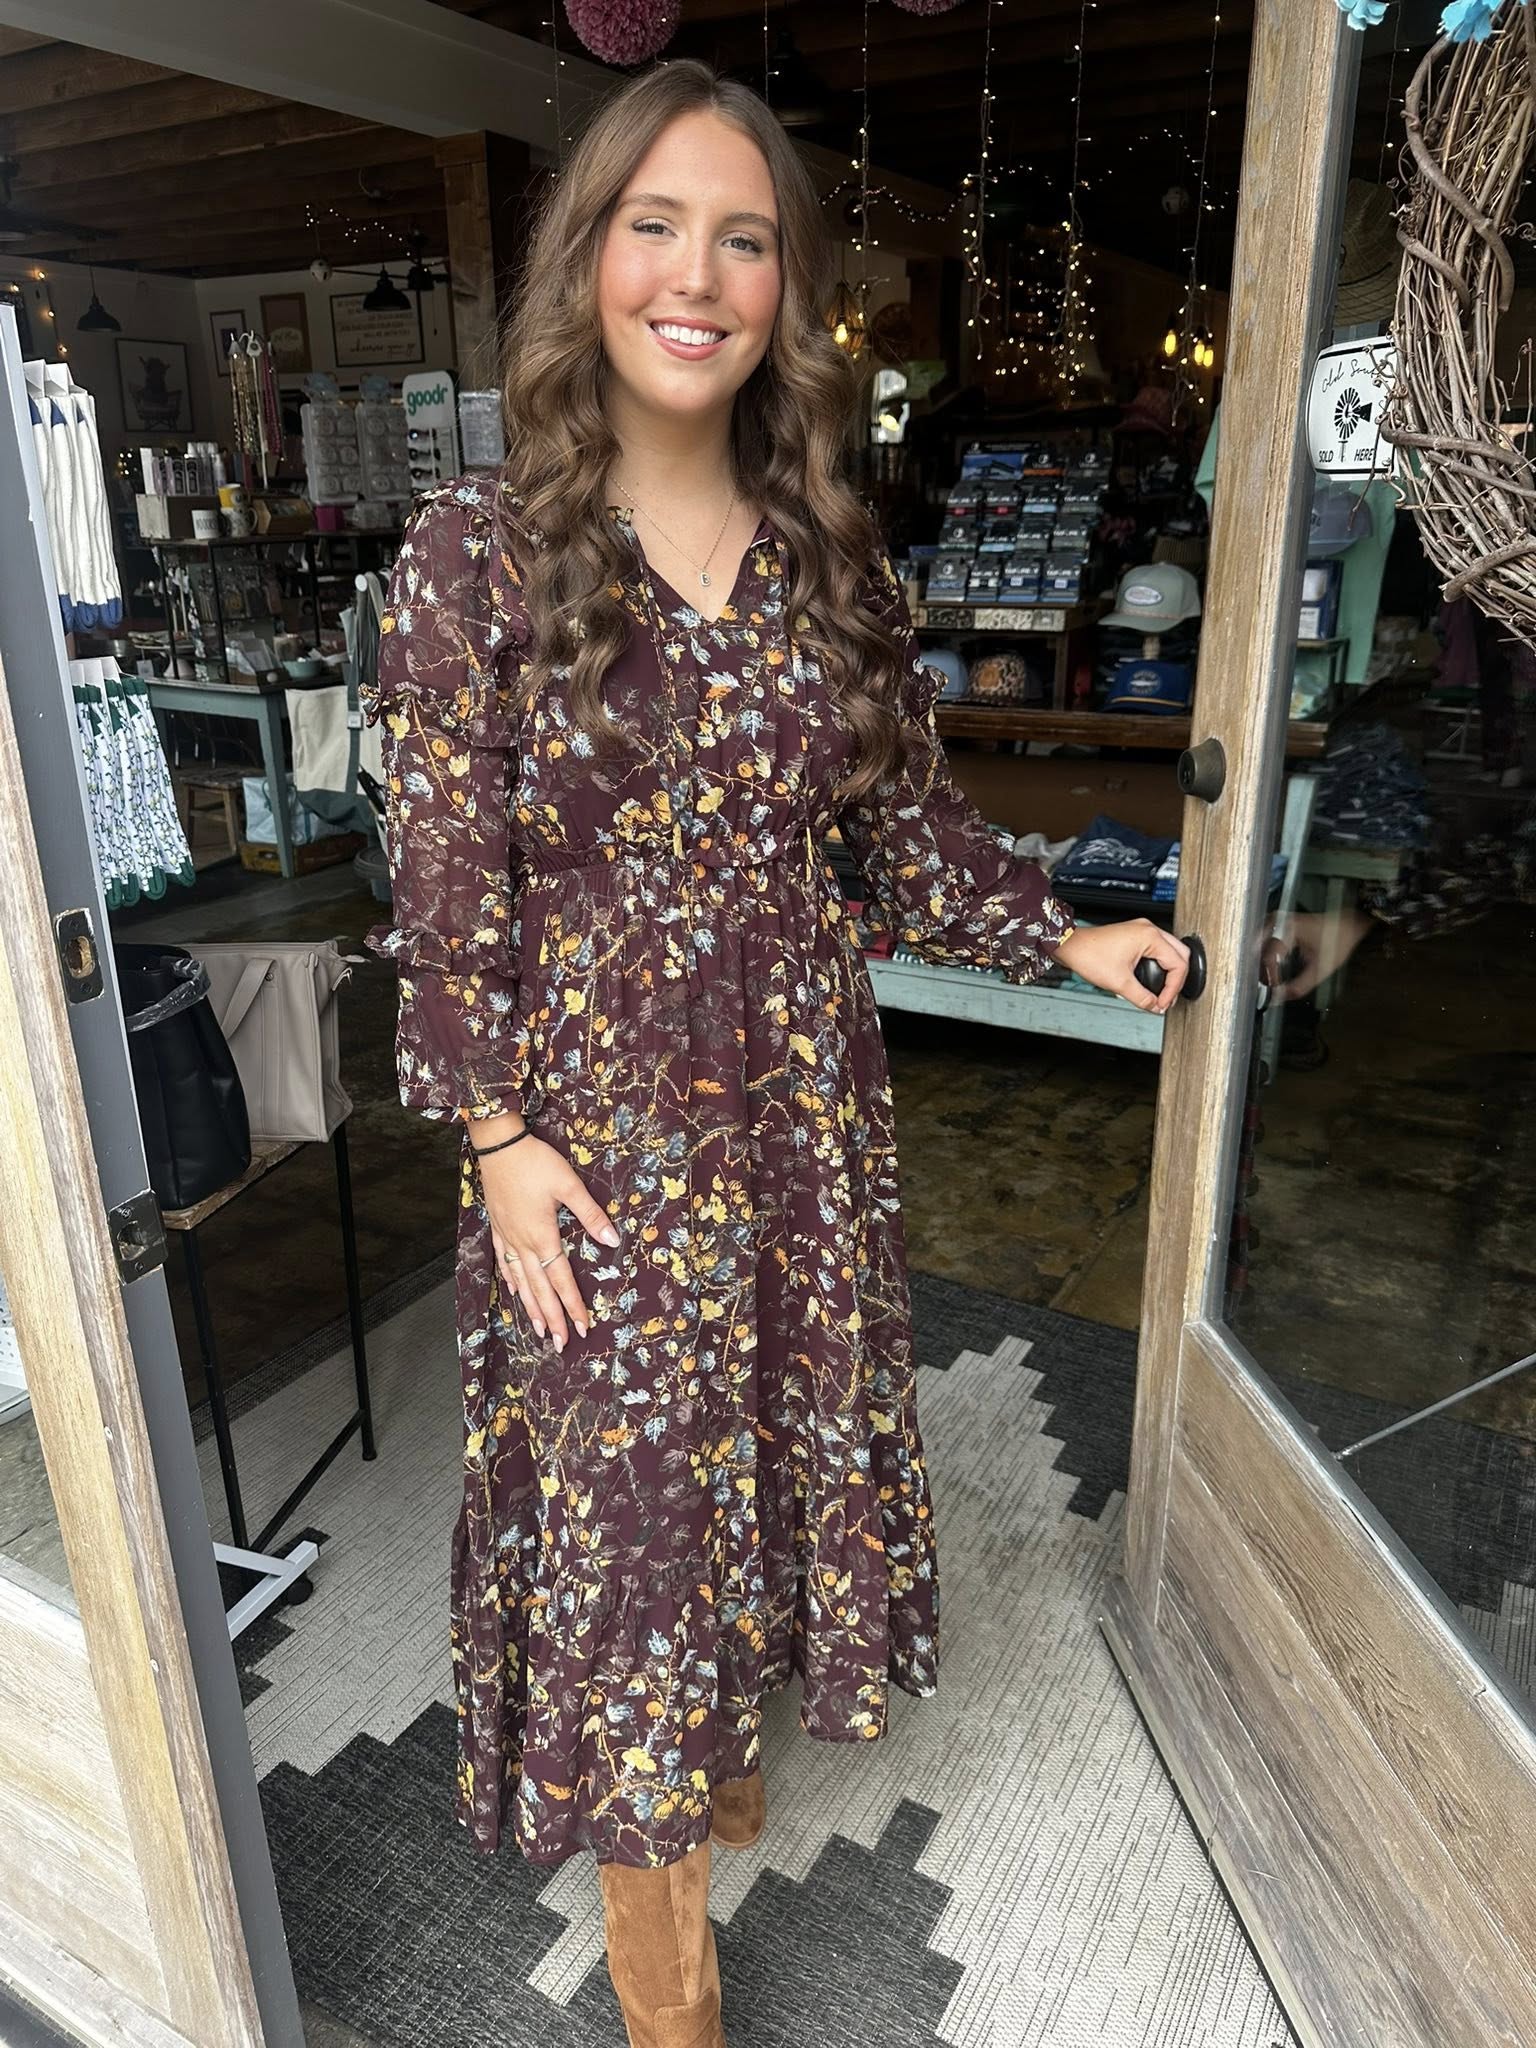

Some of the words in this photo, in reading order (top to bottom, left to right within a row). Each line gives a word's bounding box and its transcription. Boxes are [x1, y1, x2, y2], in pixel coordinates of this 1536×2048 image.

[1321, 361, 1344, 393] Old
[407, 384, 448, 416] goodr
[1318, 450, 1334, 463] SOLD
[1354, 447, 1374, 461] HERE
